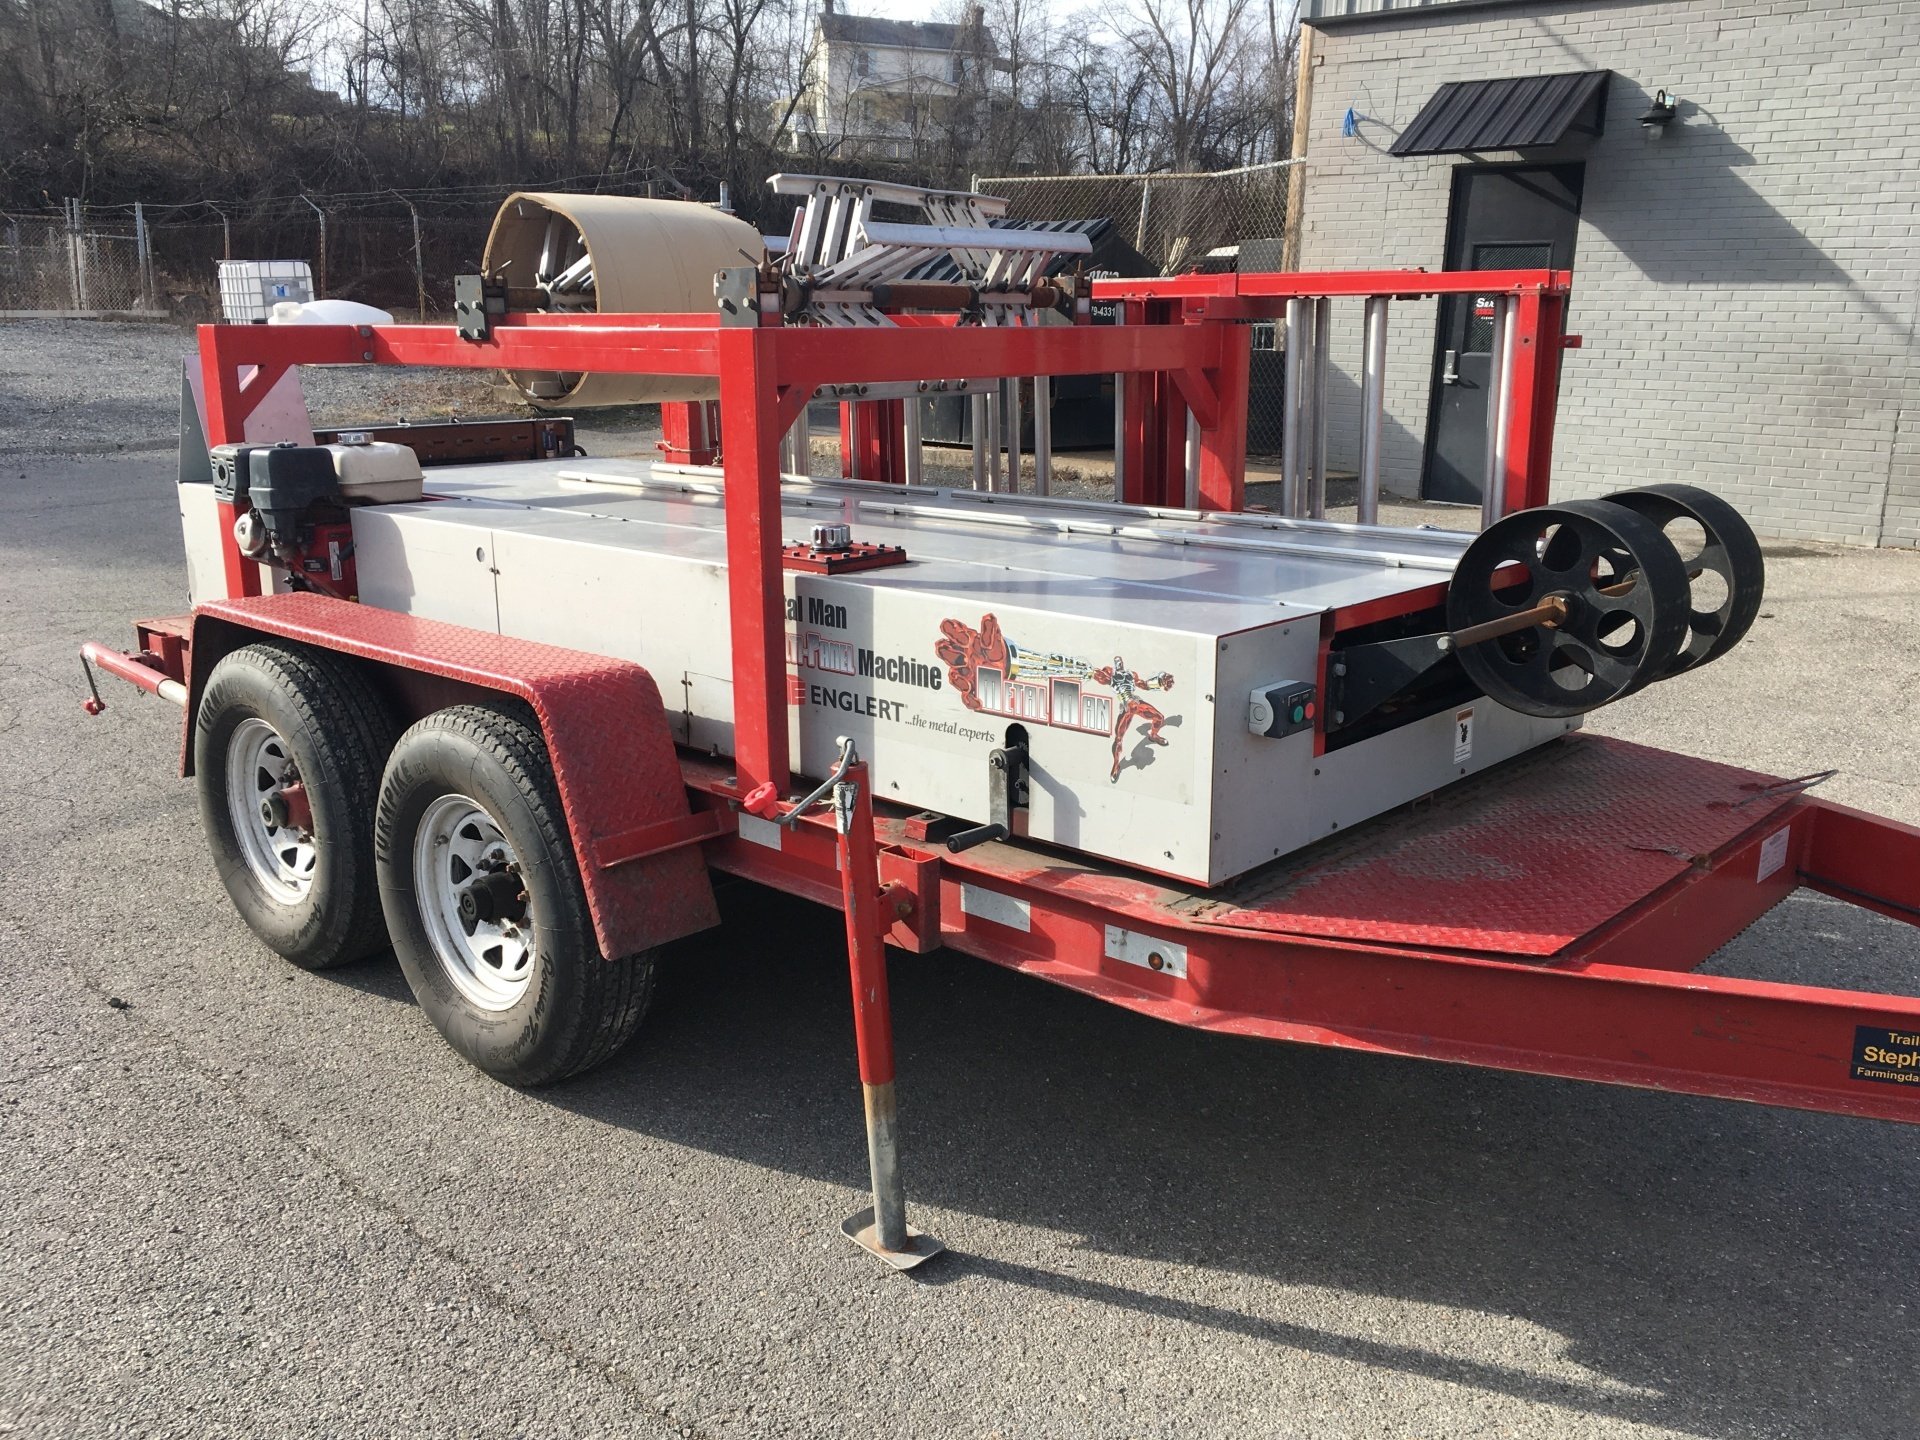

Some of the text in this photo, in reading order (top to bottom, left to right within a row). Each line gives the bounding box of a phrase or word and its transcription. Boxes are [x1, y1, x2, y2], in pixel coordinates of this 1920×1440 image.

[784, 595, 848, 629] al Man
[858, 648, 942, 690] Machine
[810, 684, 905, 723] ENGLERT
[976, 666, 1112, 733] METAL MAN
[929, 720, 958, 735] metal
[958, 727, 996, 743] experts
[376, 758, 414, 865] TURNPIKE
[1888, 1032, 1920, 1047] Trail
